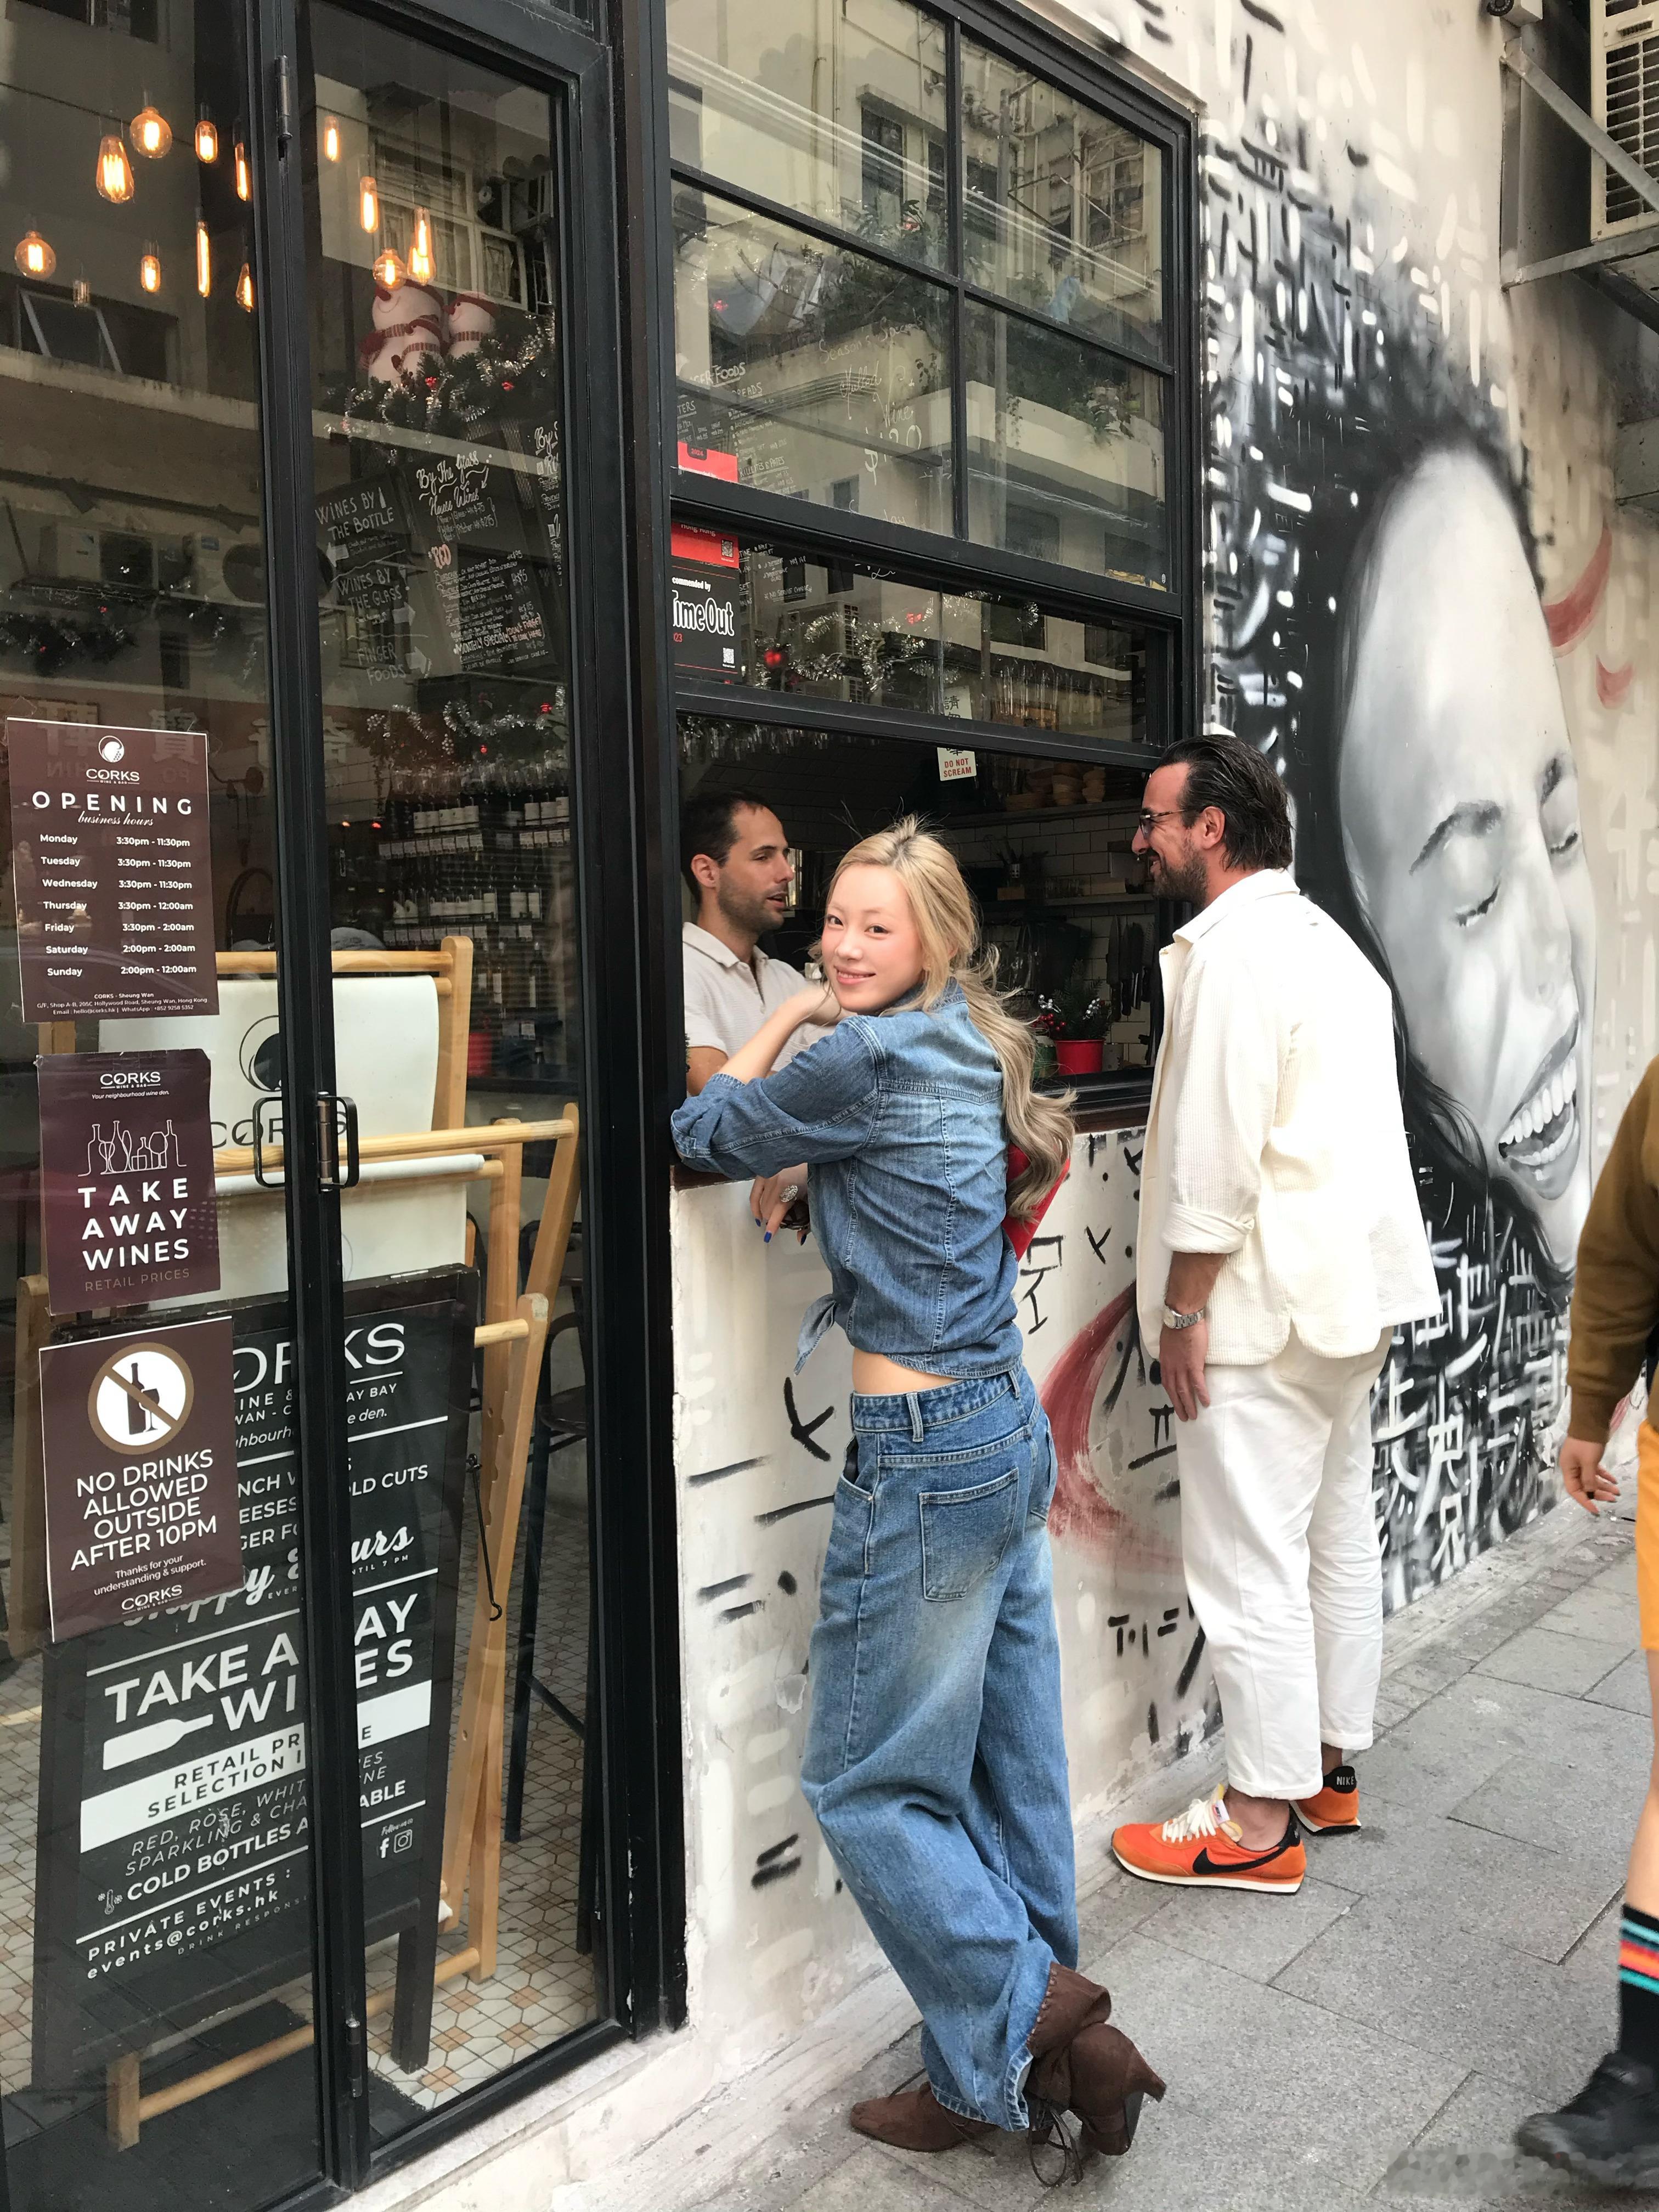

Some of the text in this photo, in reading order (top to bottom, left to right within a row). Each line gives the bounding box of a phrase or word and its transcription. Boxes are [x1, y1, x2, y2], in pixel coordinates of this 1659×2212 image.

[360, 491, 374, 510] BY
[328, 521, 350, 540] THE
[376, 568, 391, 584] BY
[672, 577, 712, 592] commended by
[348, 585, 402, 614] THE GLASS
[357, 642, 397, 665] FINGER
[86, 769, 140, 782] CORKS
[943, 766, 972, 778] SCREAM
[944, 758, 969, 769] DO NOT
[32, 791, 192, 815] OPENING
[77, 810, 154, 826] business hours
[40, 834, 190, 847] Monday 3:30pm 11:30pm
[41, 856, 191, 868] Tuesday 3:30pm 11:30pm
[42, 879, 192, 890] Wednesday 3:30pm 11:30pm
[43, 901, 193, 911] Thursday 3:30pm 12:00am
[44, 923, 195, 933] Friday 3:30pm 2:00am
[46, 944, 196, 955] Saturday 2:00pm 2:00am
[47, 966, 197, 977] Sunday 2:00pm 12:00am
[100, 1071, 161, 1086] CORKS
[105, 1091, 145, 1099] neighbourhood
[78, 1178, 188, 1208] TAKE
[82, 1208, 188, 1240] AWAY
[82, 1238, 189, 1271] WINES
[85, 1268, 190, 1291] RETAIL PRICES
[240, 1392, 273, 1410] INE
[370, 1383, 398, 1398] BAY
[359, 1407, 387, 1422] den.
[77, 1449, 213, 1498] NO DRINKS
[83, 1473, 208, 1520] ALLOWED
[238, 1474, 280, 1498] NCH
[239, 1464, 428, 1524] EESES LD CUTS
[94, 1497, 201, 1539] OUTSIDE
[71, 1515, 217, 1571] AFTER 10PM
[94, 1559, 207, 1595] understanding & support.
[115, 1555, 183, 1579] Thanks for your
[268, 1585, 297, 1599] EVER
[352, 1564, 375, 1575] NTIL
[394, 1554, 408, 1564] PM
[121, 1584, 182, 1611] CORKS
[105, 1644, 250, 1724] TAKE
[174, 1748, 260, 1789] RETAIL
[148, 1756, 284, 1818] SELECTION
[1337, 1776, 1355, 1786] NIKE
[126, 1813, 261, 1876] SPARKLING &
[132, 1830, 179, 1857] RED,
[127, 1823, 291, 1901] COLD BOTTLES
[88, 1872, 276, 1961] PRIVATE EVENTS
[177, 1895, 307, 1955] DRINK RESPONSI
[87, 1890, 279, 1979] events@corks.hk
